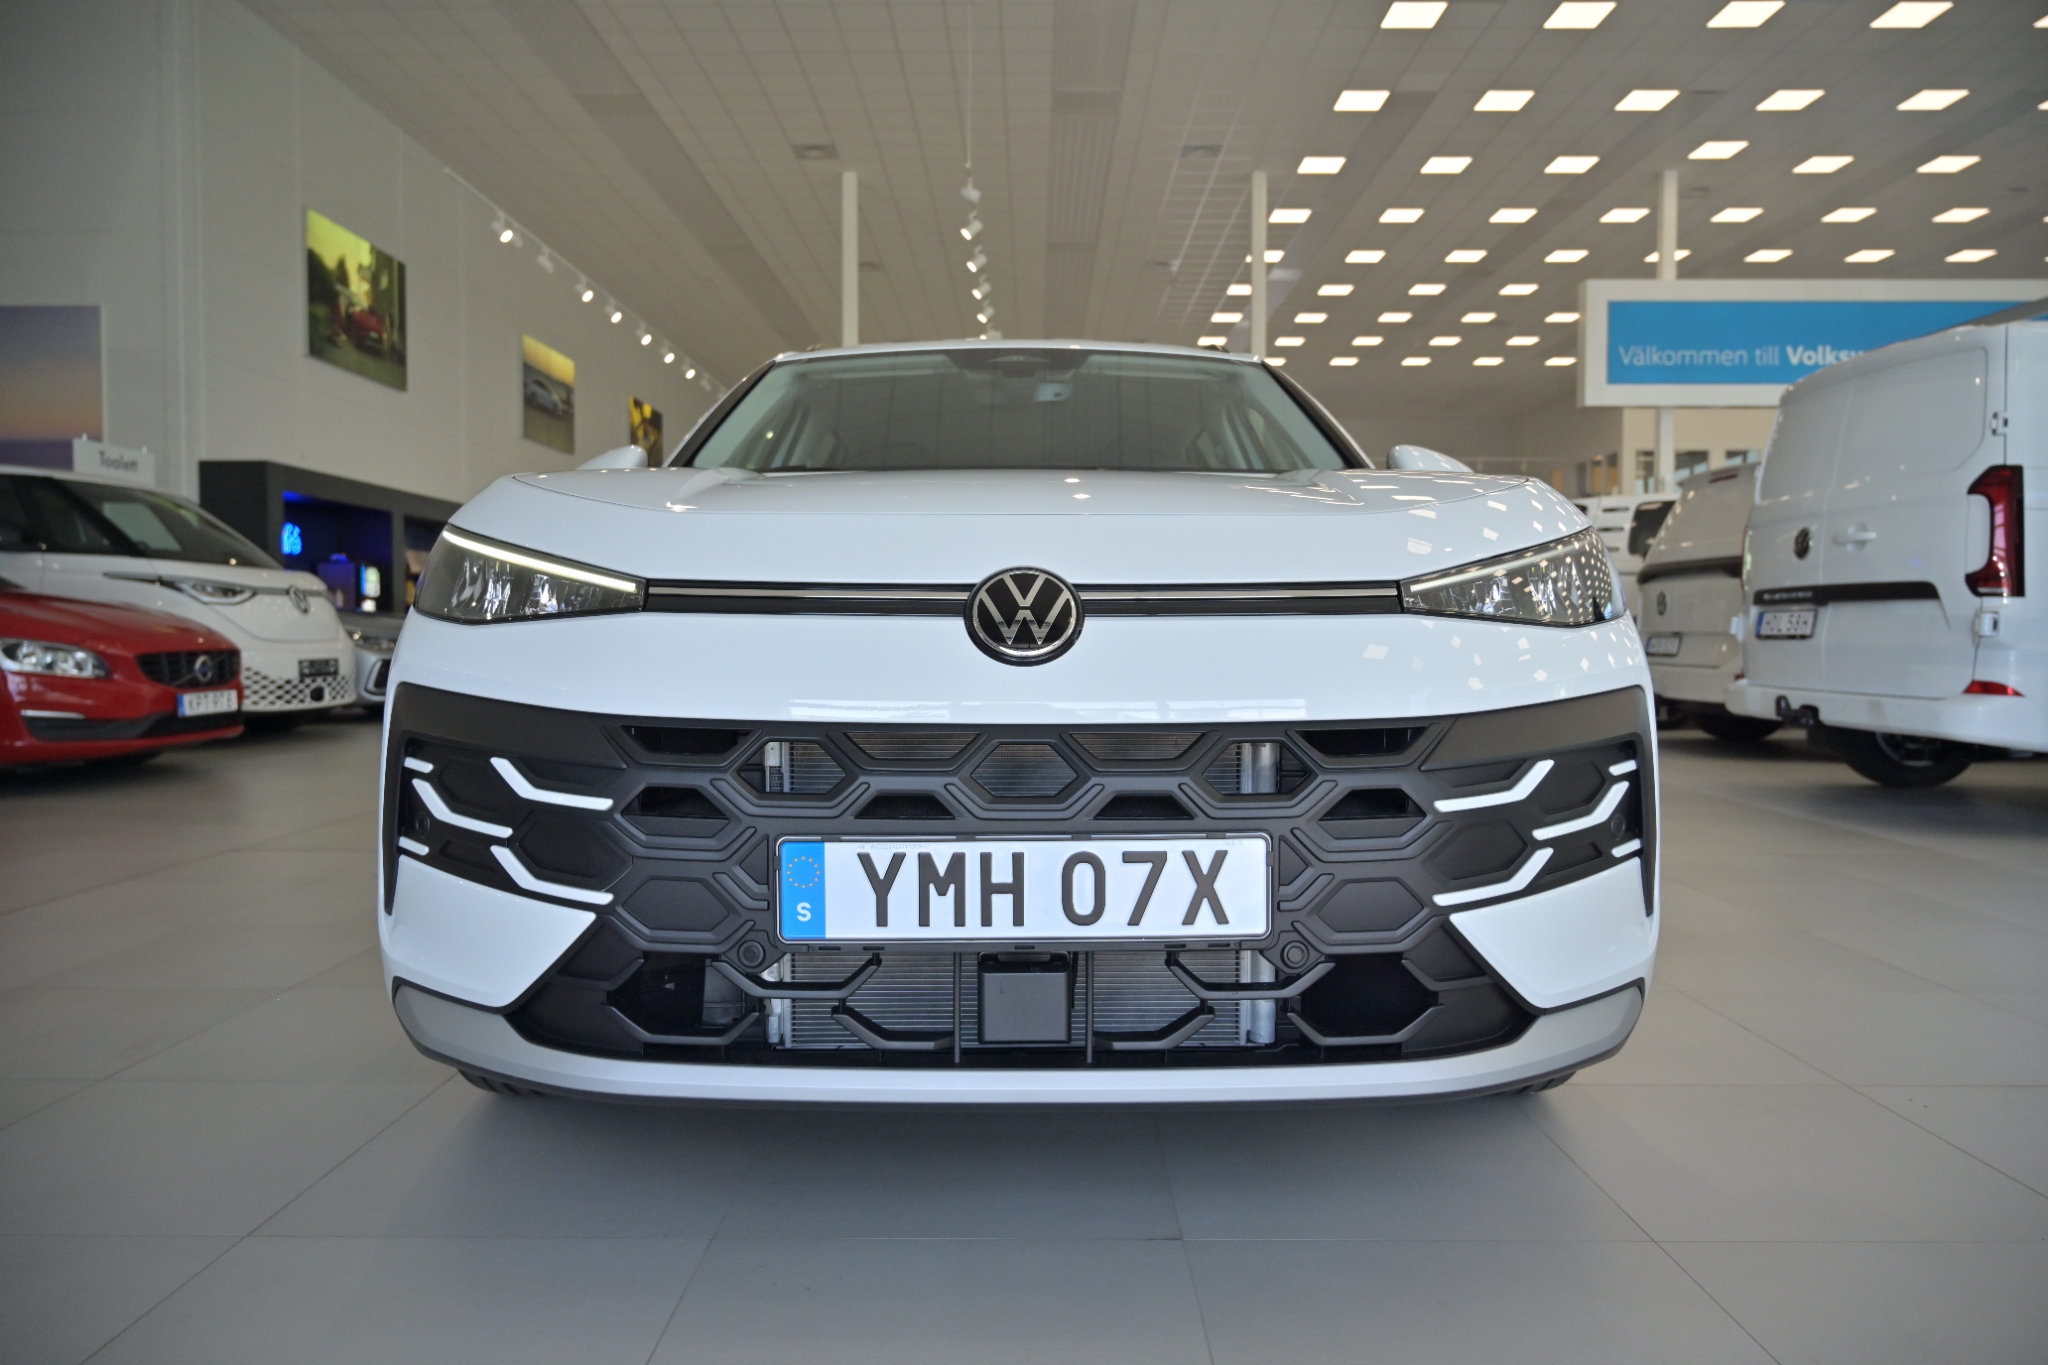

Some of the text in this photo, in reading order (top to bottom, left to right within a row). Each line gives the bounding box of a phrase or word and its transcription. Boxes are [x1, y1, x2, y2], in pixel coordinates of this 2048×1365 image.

[1619, 345, 1864, 367] Välkommen till Volks
[857, 850, 1230, 928] YMH 07X
[796, 902, 812, 922] S
